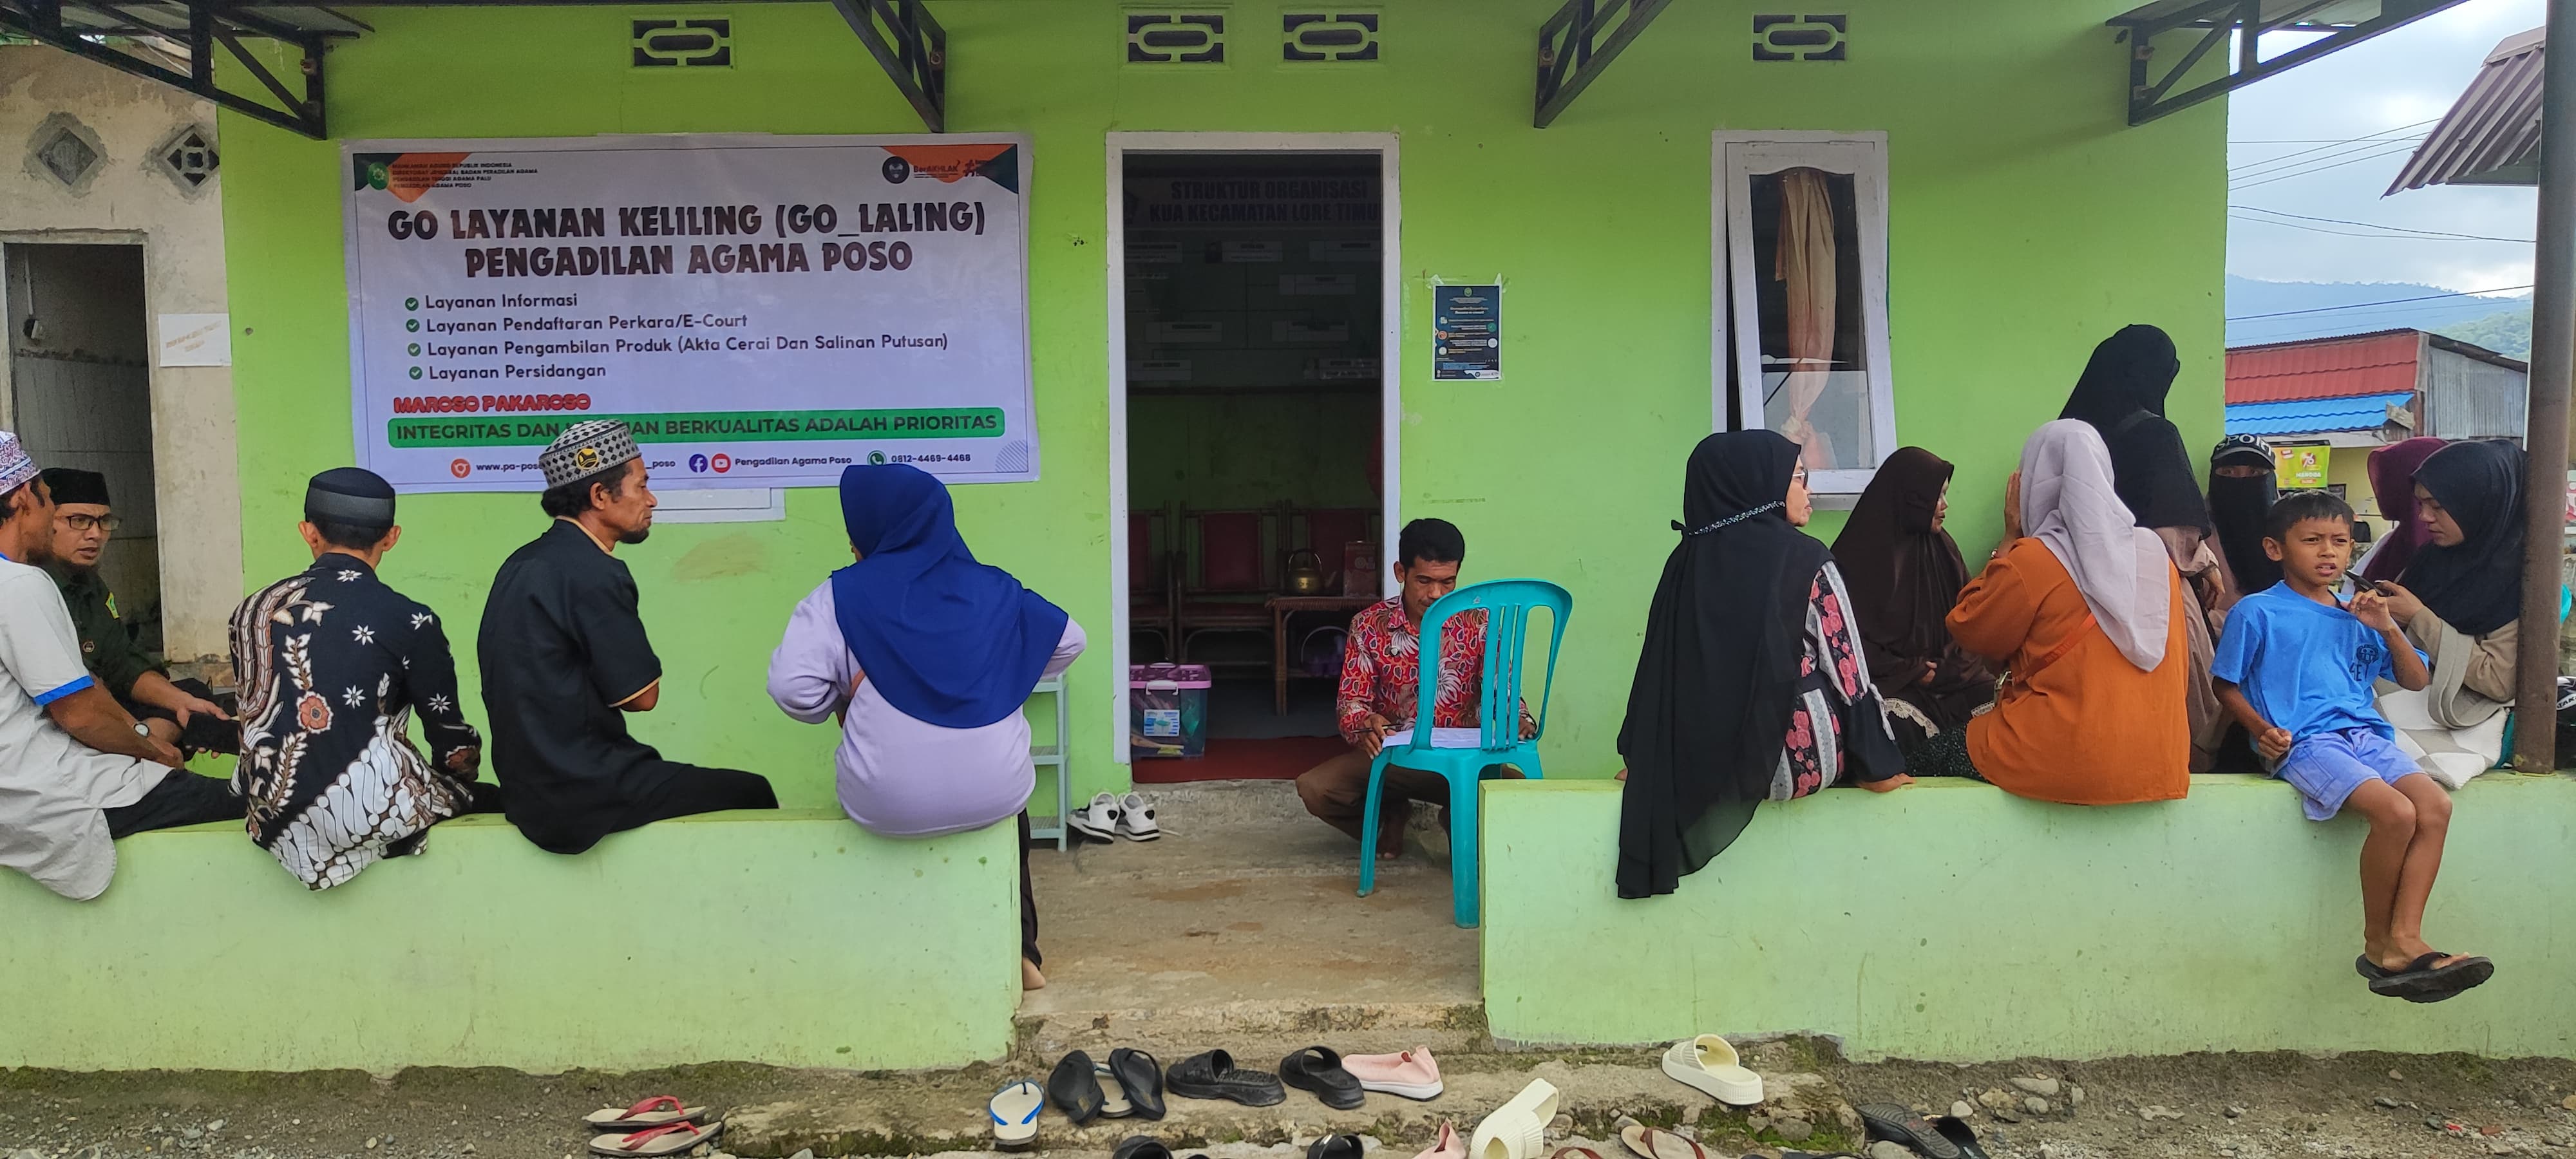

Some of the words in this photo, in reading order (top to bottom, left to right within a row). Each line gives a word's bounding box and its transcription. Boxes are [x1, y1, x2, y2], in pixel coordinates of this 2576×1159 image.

[1171, 180, 1265, 200] STRUKTUR
[1266, 180, 1368, 199] ORGANISASI
[388, 211, 439, 240] GO
[451, 207, 605, 240] LAYANAN
[619, 205, 762, 236] KELILING
[775, 202, 985, 238] (GO_LALING)
[1150, 204, 1184, 223] KUA
[1188, 203, 1288, 222] KECAMATAN
[1291, 203, 1331, 221] LORE
[1335, 203, 1380, 221] TIMU
[465, 245, 674, 278] PENGADILAN
[687, 243, 810, 274] AGAMA
[822, 241, 913, 272] POSO
[426, 295, 495, 312] Layanan
[502, 293, 578, 308] Informasi
[427, 318, 497, 335] Layanan
[504, 316, 603, 332] Pendaftaran
[609, 313, 748, 330] Perkara/E-Court
[428, 342, 498, 359] Layanan
[504, 339, 609, 357] Pengambilan
[616, 339, 672, 353] Produk
[678, 335, 720, 352] (Akta
[726, 336, 770, 351] Cerai
[777, 335, 809, 350] Dan
[815, 335, 875, 349] Salinan
[882, 332, 948, 350] Putusan)
[430, 366, 499, 382] Layanan
[506, 363, 606, 380] Persidangan
[393, 395, 480, 413] MAROSO
[482, 393, 591, 412] PAKAROSO
[397, 424, 511, 440] INTEGRITAS
[517, 423, 559, 438] DAN
[666, 418, 800, 435] BERKUALITAS
[805, 416, 887, 431] ADALAH
[894, 414, 998, 430] PRIORITAS
[645, 461, 676, 469] _poso
[735, 457, 790, 467] Pengadilan
[791, 457, 828, 467] Agama
